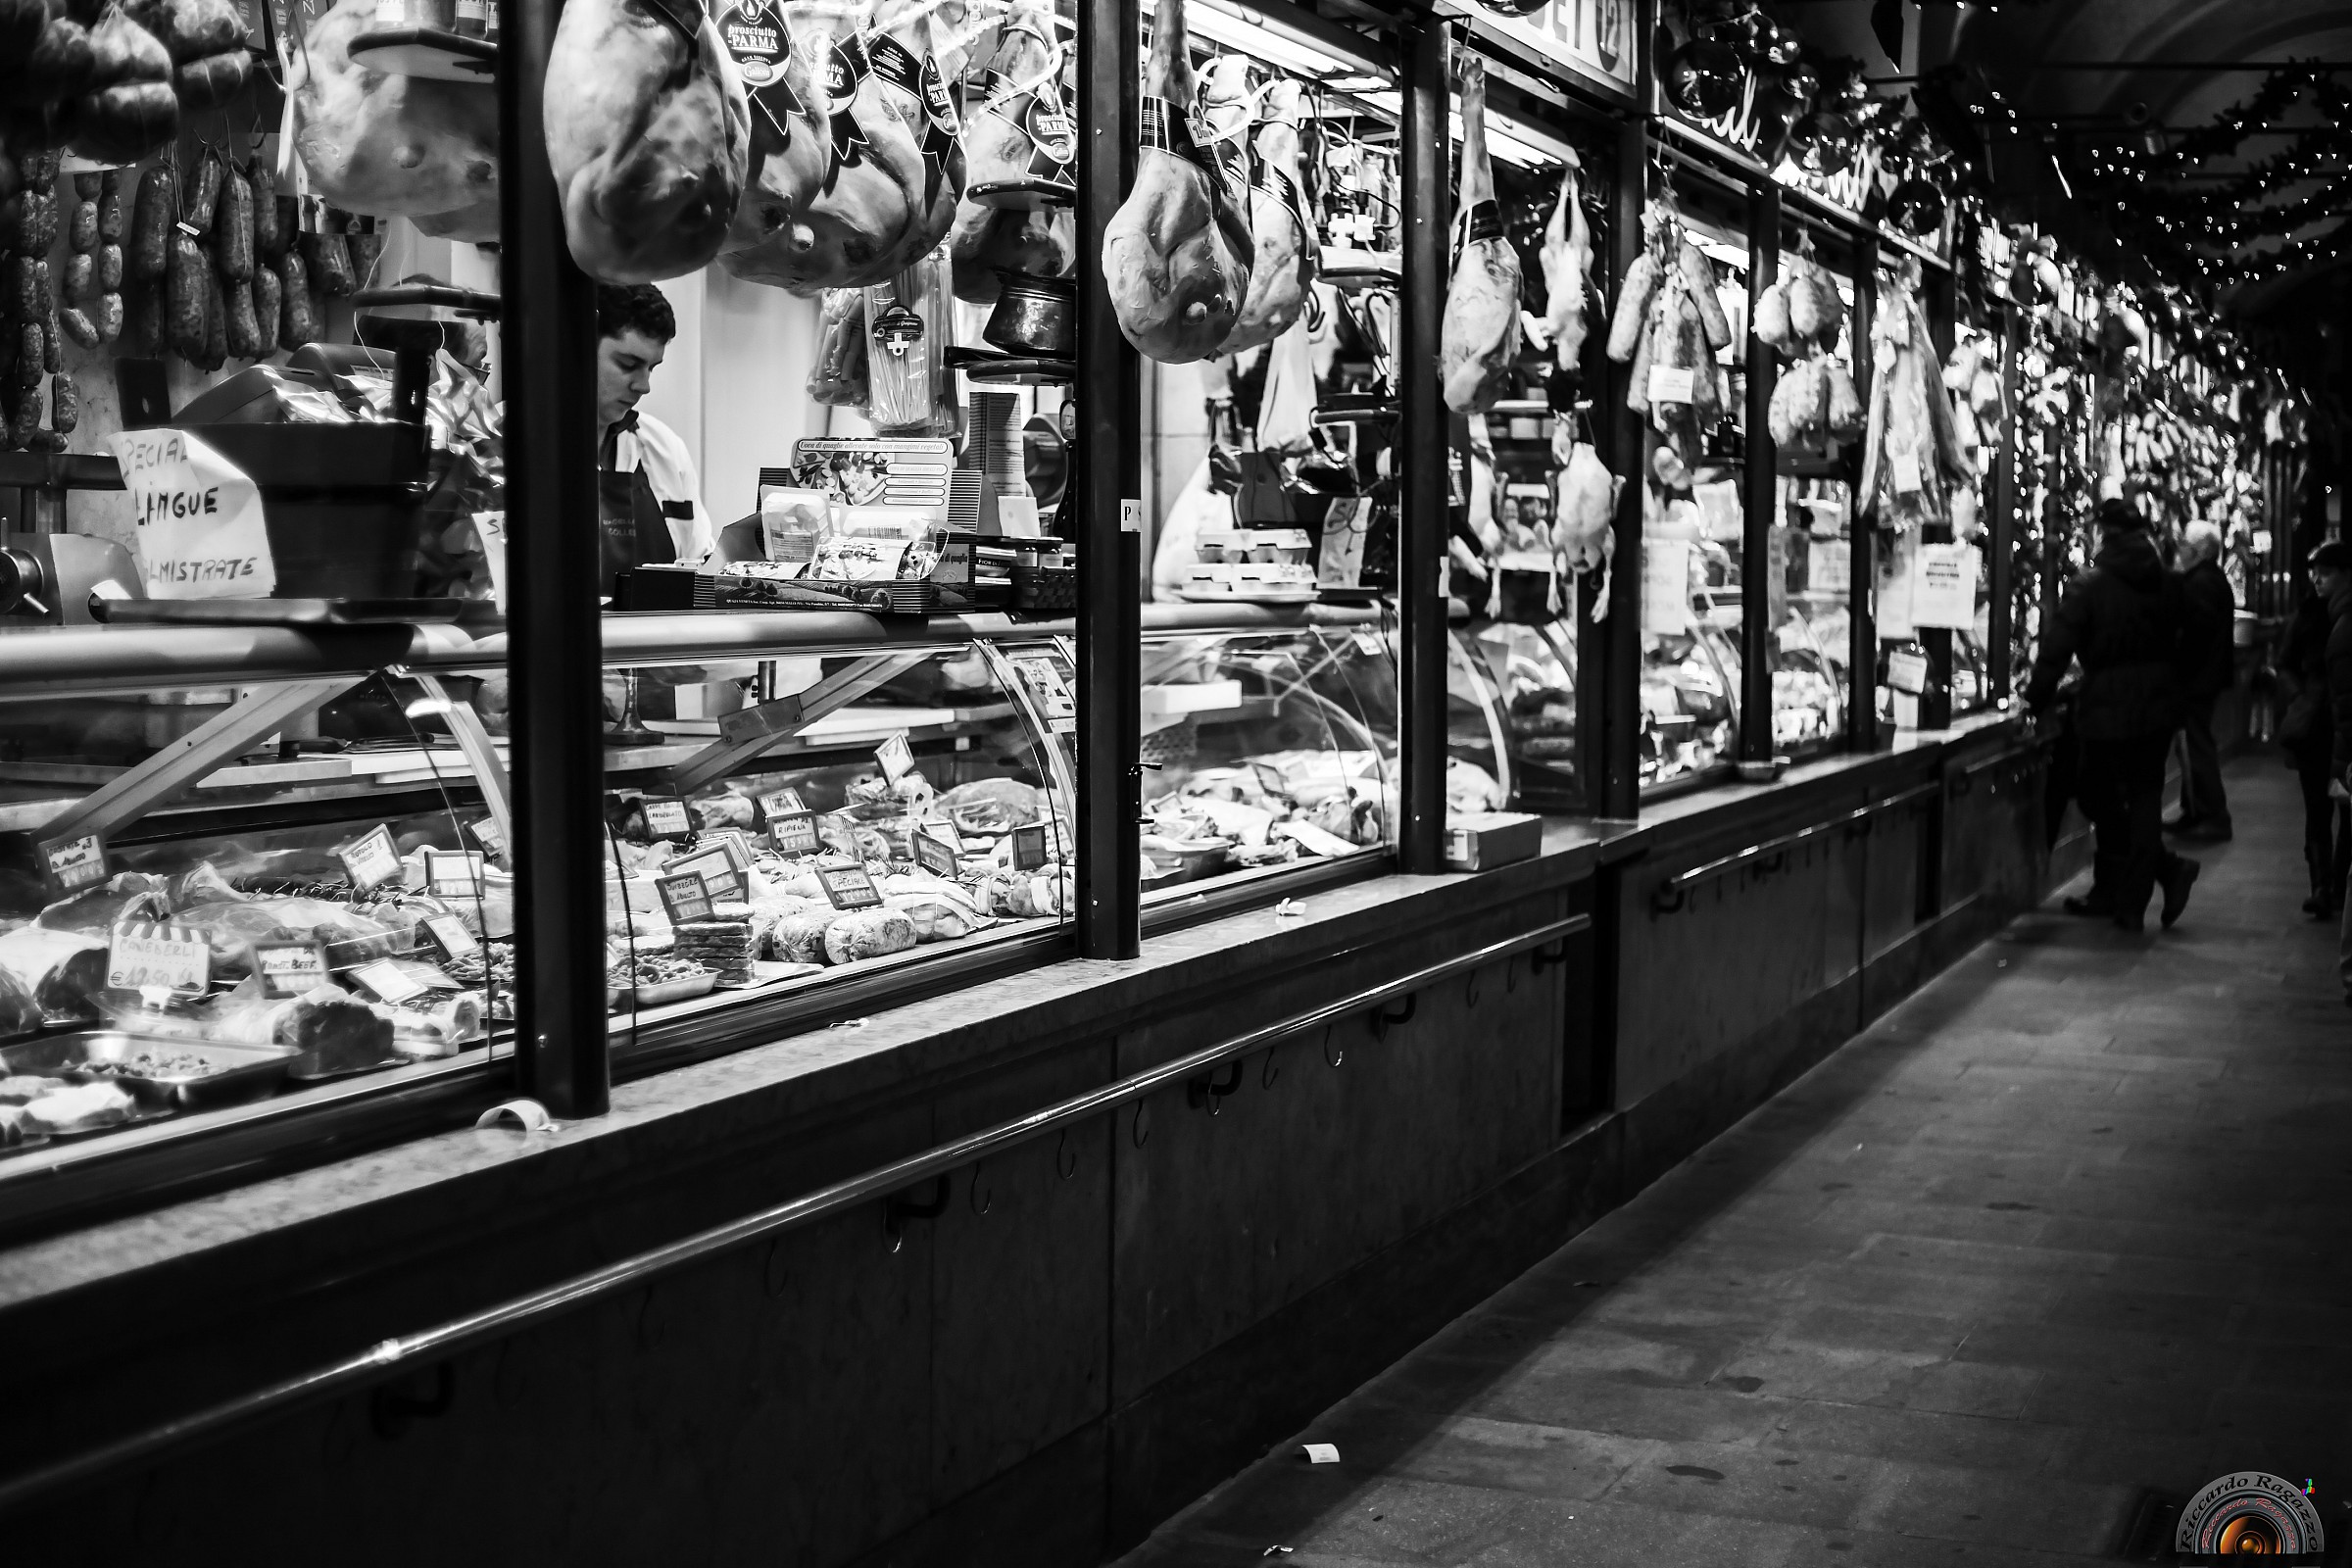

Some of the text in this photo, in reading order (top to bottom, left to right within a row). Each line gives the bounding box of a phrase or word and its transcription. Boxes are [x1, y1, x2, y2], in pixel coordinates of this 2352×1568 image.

[728, 24, 777, 37] prosciutto
[732, 34, 779, 49] PARMA
[135, 486, 219, 526] LINGUE
[149, 557, 258, 583] LMISTRATE
